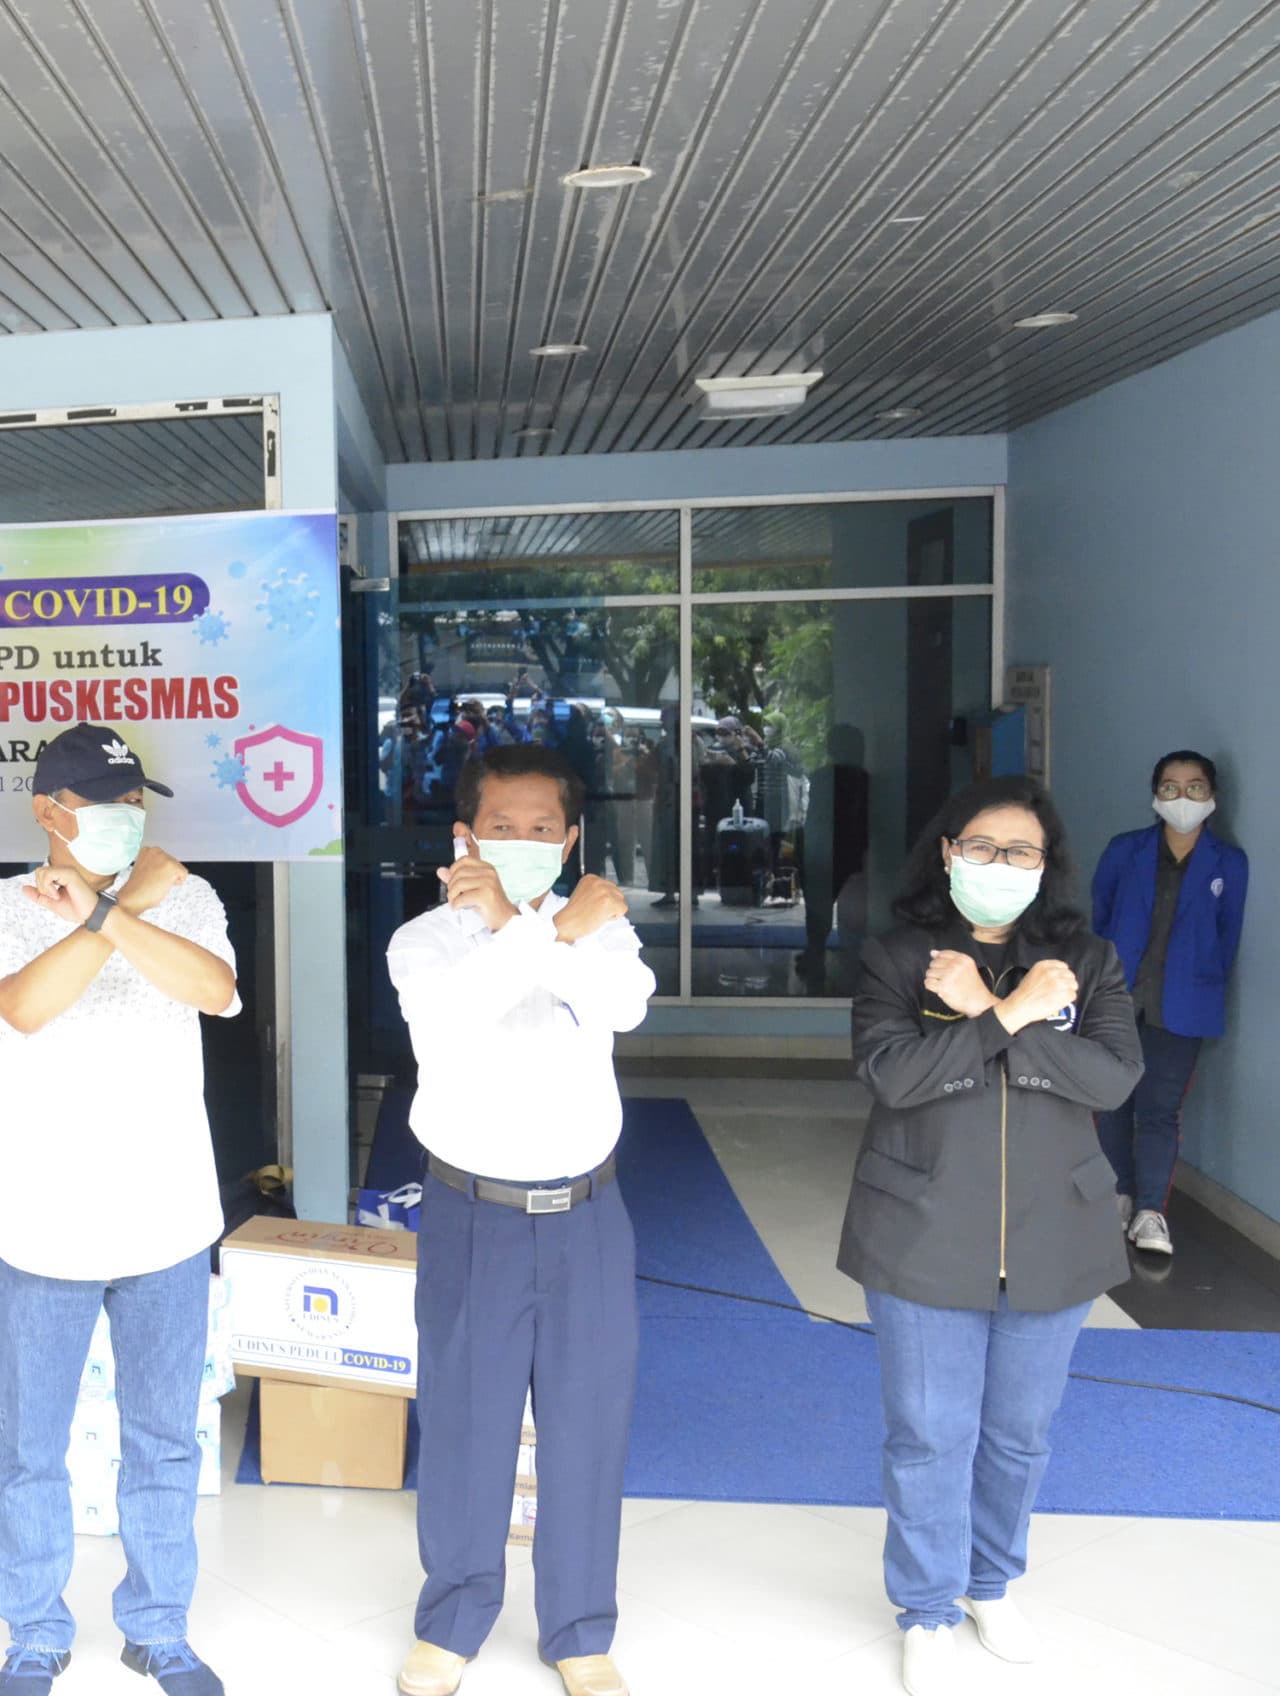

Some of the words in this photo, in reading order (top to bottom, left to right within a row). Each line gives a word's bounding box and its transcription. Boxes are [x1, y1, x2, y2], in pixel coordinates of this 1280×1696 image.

[4, 585, 193, 620] COVID-19
[53, 641, 163, 669] untuk
[12, 775, 34, 792] 20
[238, 1339, 286, 1354] UDINUS
[290, 1345, 338, 1362] PEDULI
[343, 1352, 407, 1372] COVID-19
